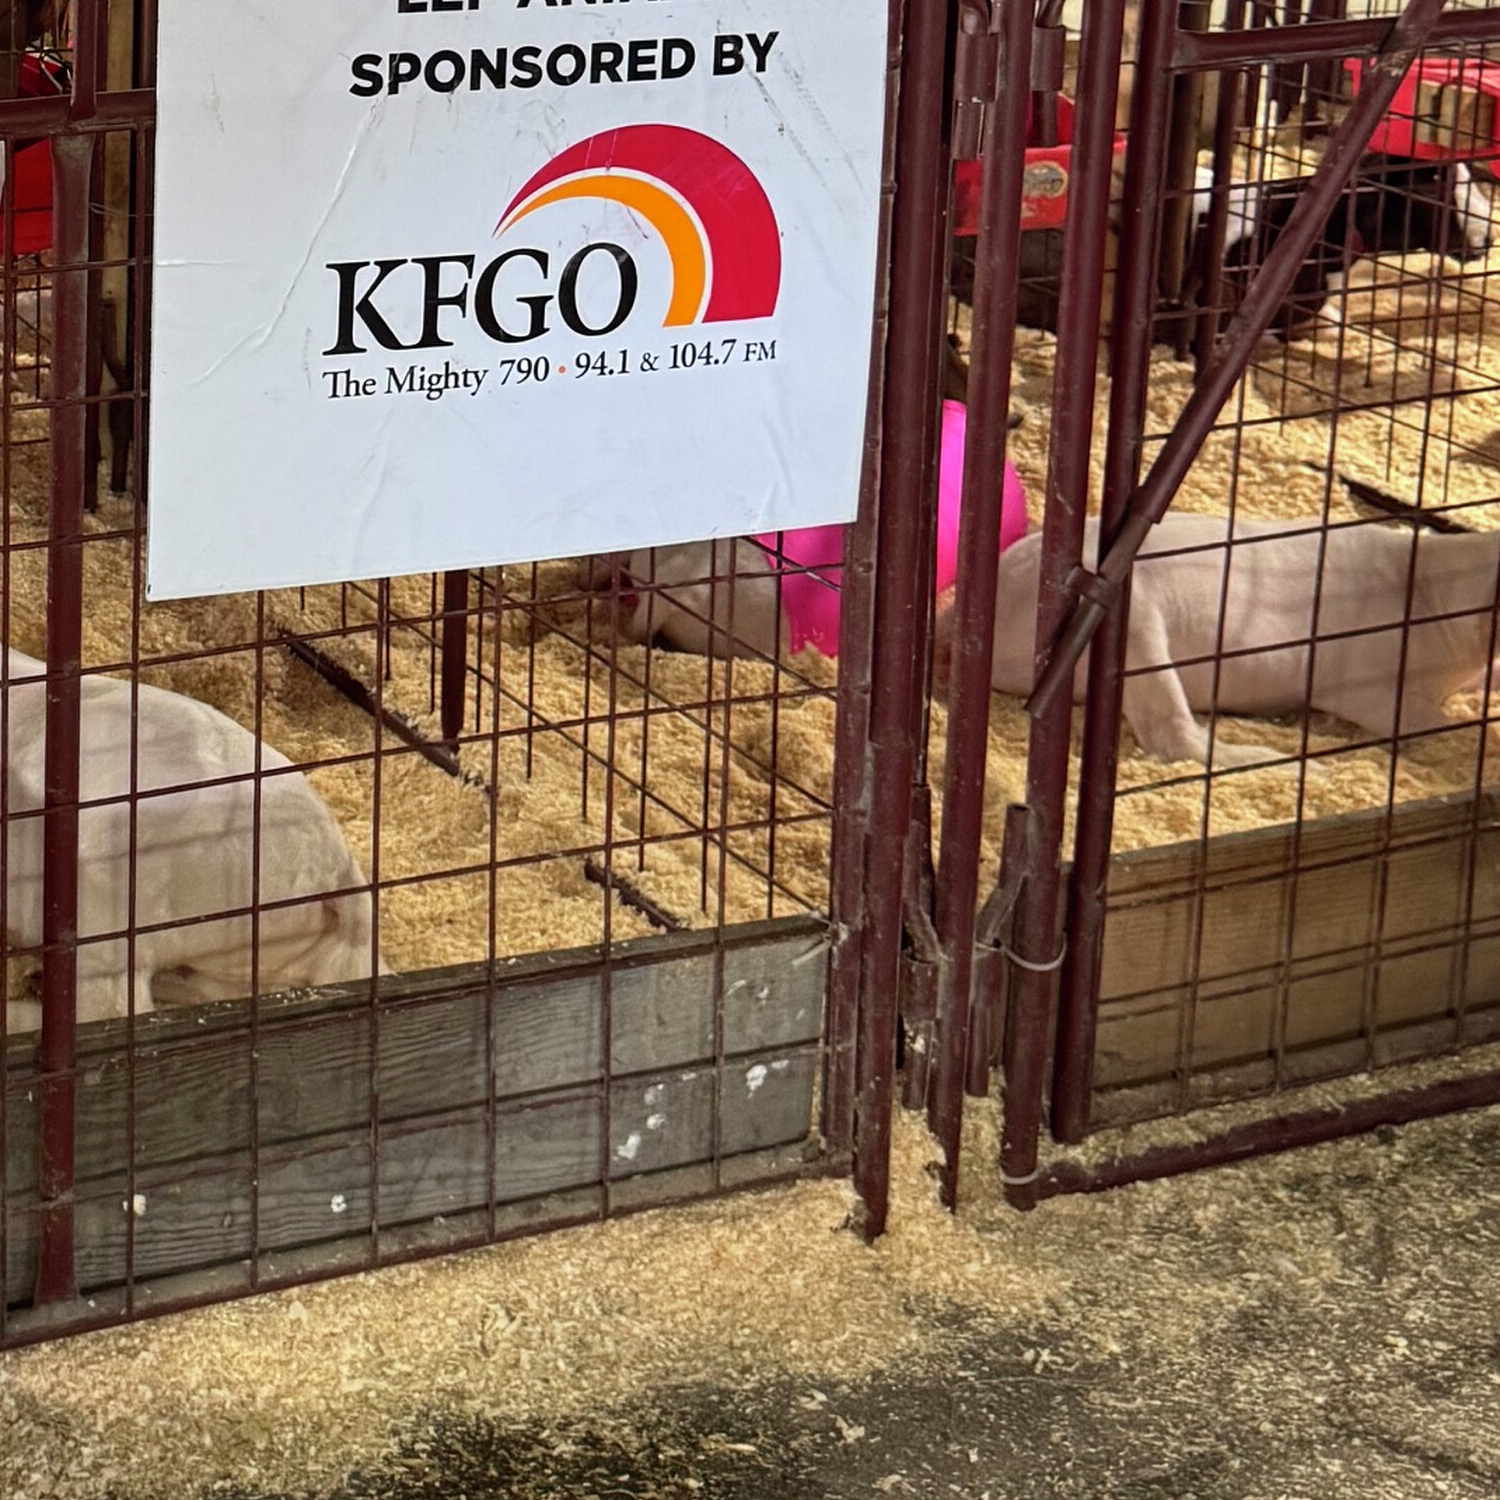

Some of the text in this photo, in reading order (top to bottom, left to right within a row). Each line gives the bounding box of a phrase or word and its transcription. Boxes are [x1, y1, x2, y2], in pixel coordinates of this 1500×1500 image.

[350, 31, 779, 97] SPONSORED BY
[322, 242, 638, 355] KFGO
[322, 338, 778, 401] The Mighty 790 94.1 & 104.7 FM
